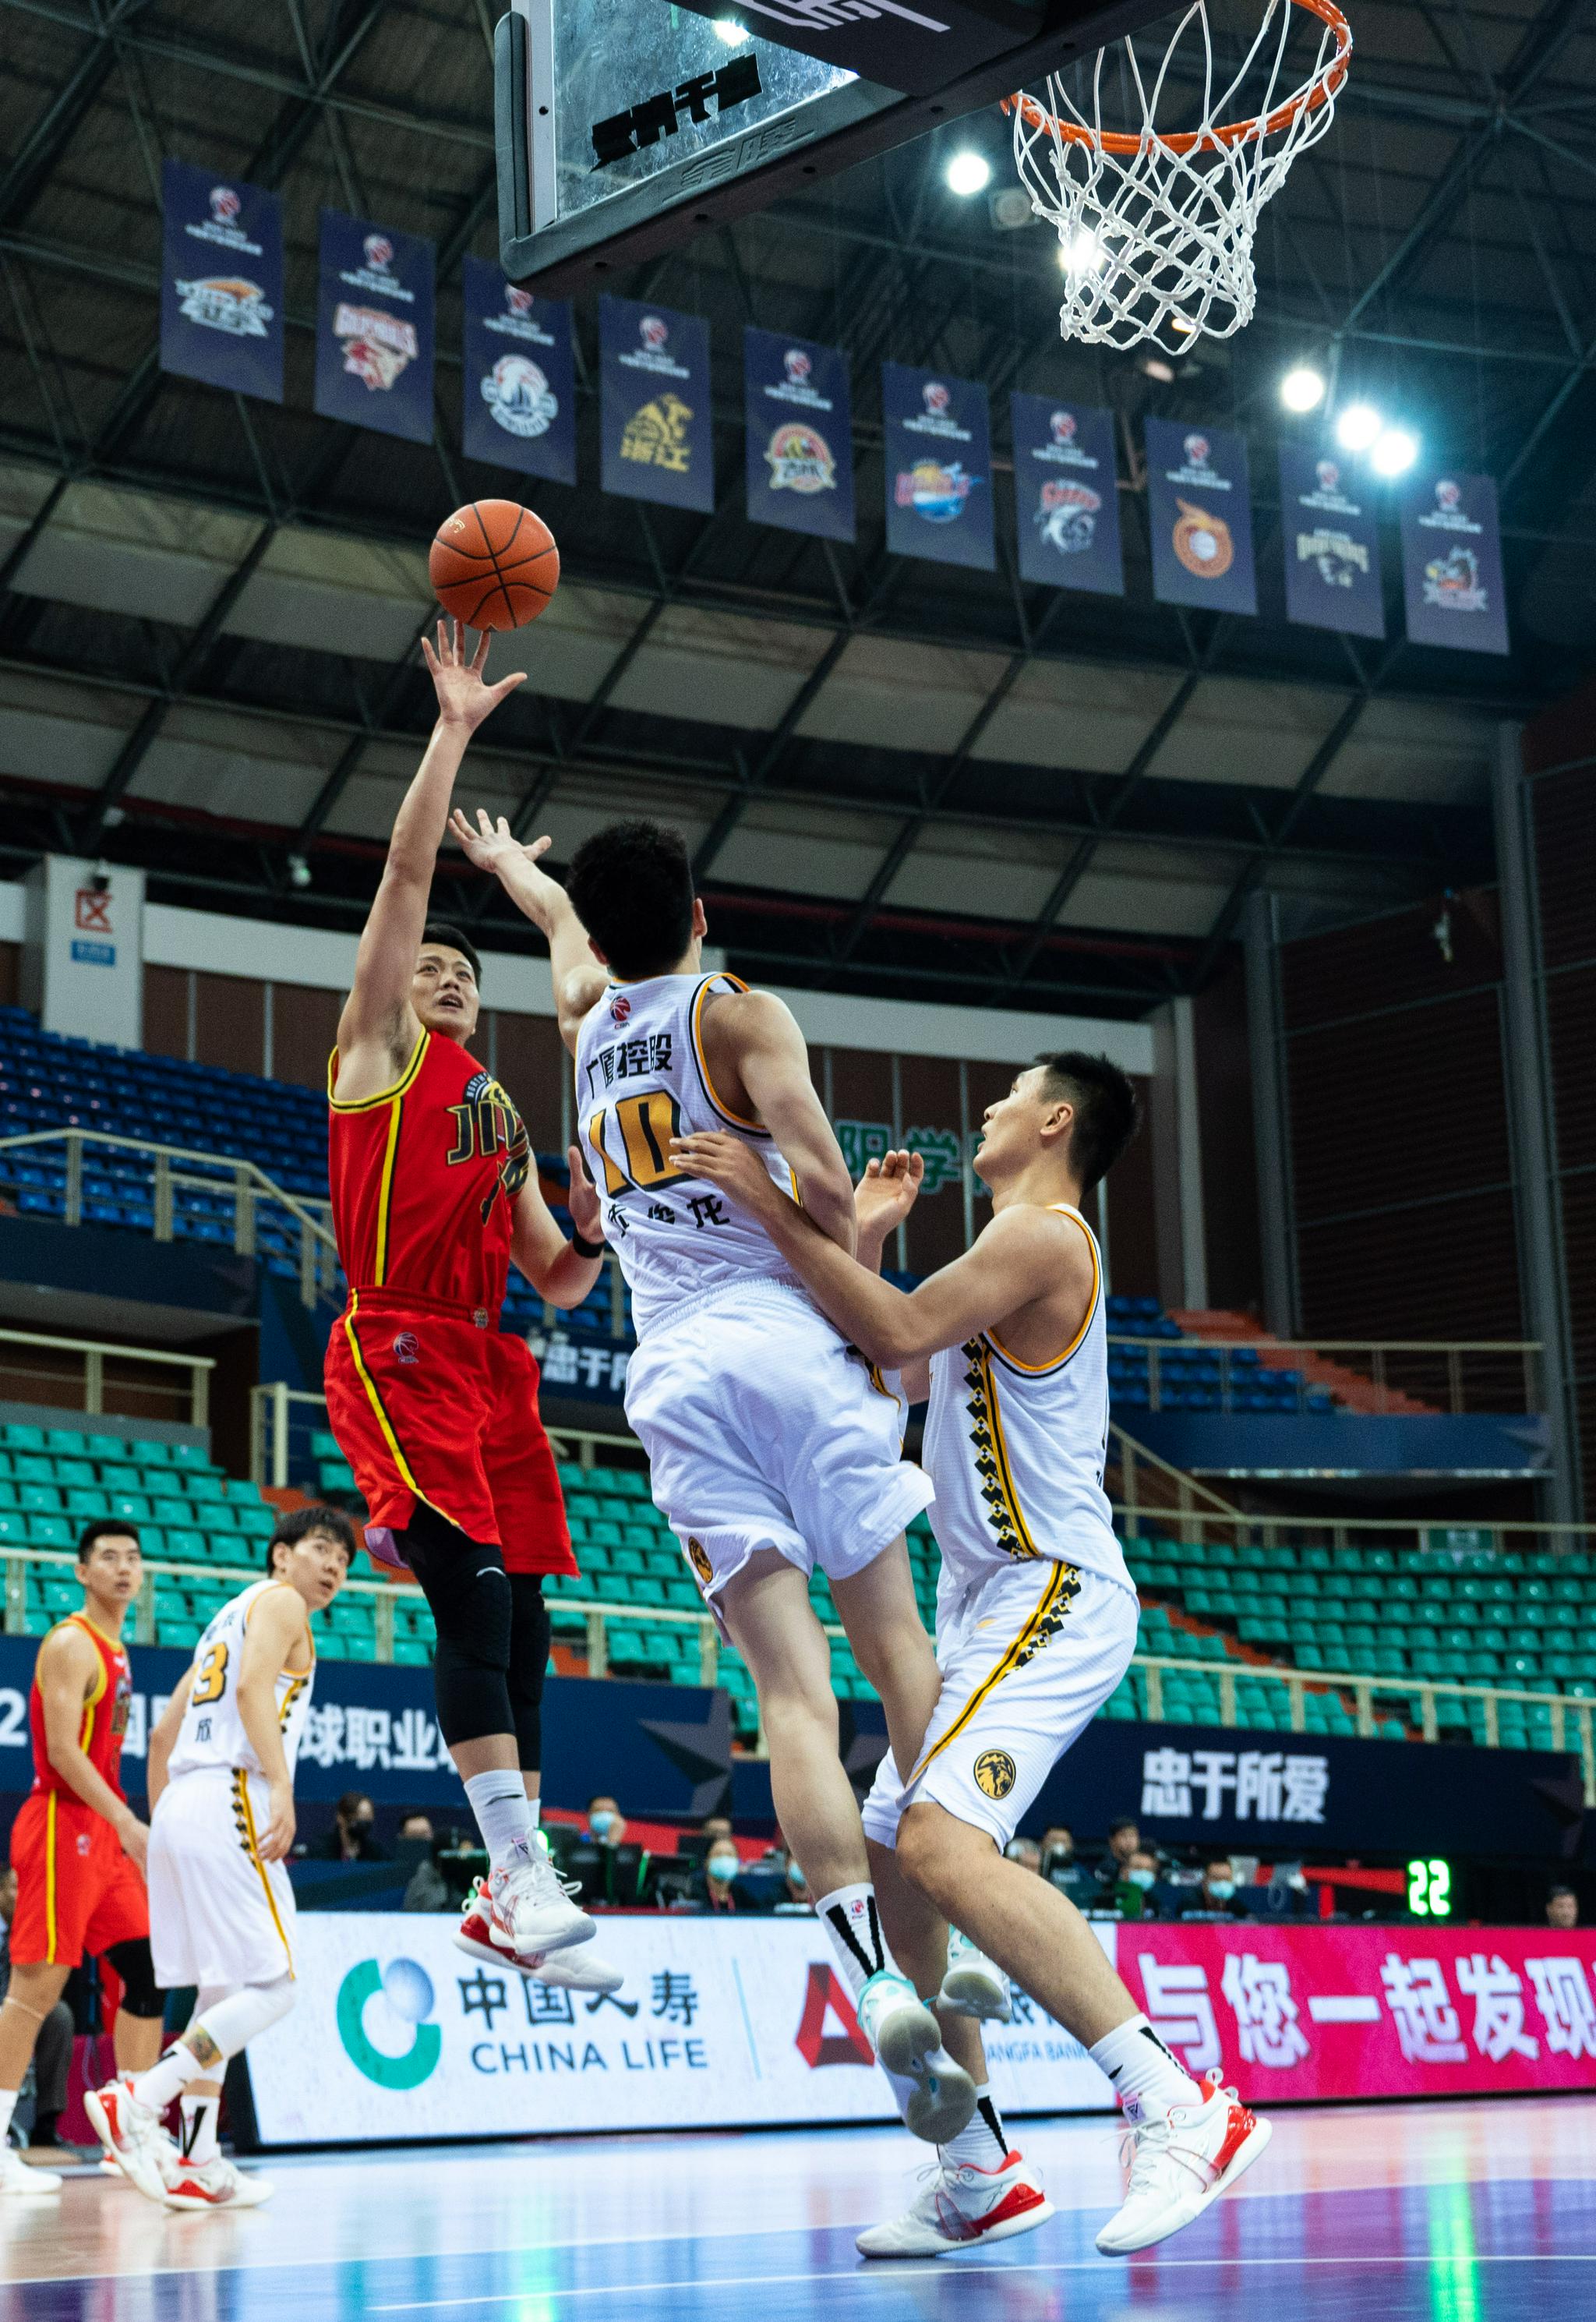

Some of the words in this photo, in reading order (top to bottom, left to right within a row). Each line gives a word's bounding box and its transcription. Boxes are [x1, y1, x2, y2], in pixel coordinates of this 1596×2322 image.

[586, 1034, 673, 1100] 广厦控股
[588, 1089, 699, 1200] 10
[835, 1119, 993, 1196] 阳学
[1141, 1747, 1329, 1823] 忠于所爱
[1407, 1859, 1451, 1917] 22
[458, 1967, 698, 2030] 中国人寿
[470, 2040, 608, 2075] CHINA
[622, 2038, 708, 2070] LIFE
[985, 2040, 1043, 2062] ANGFA
